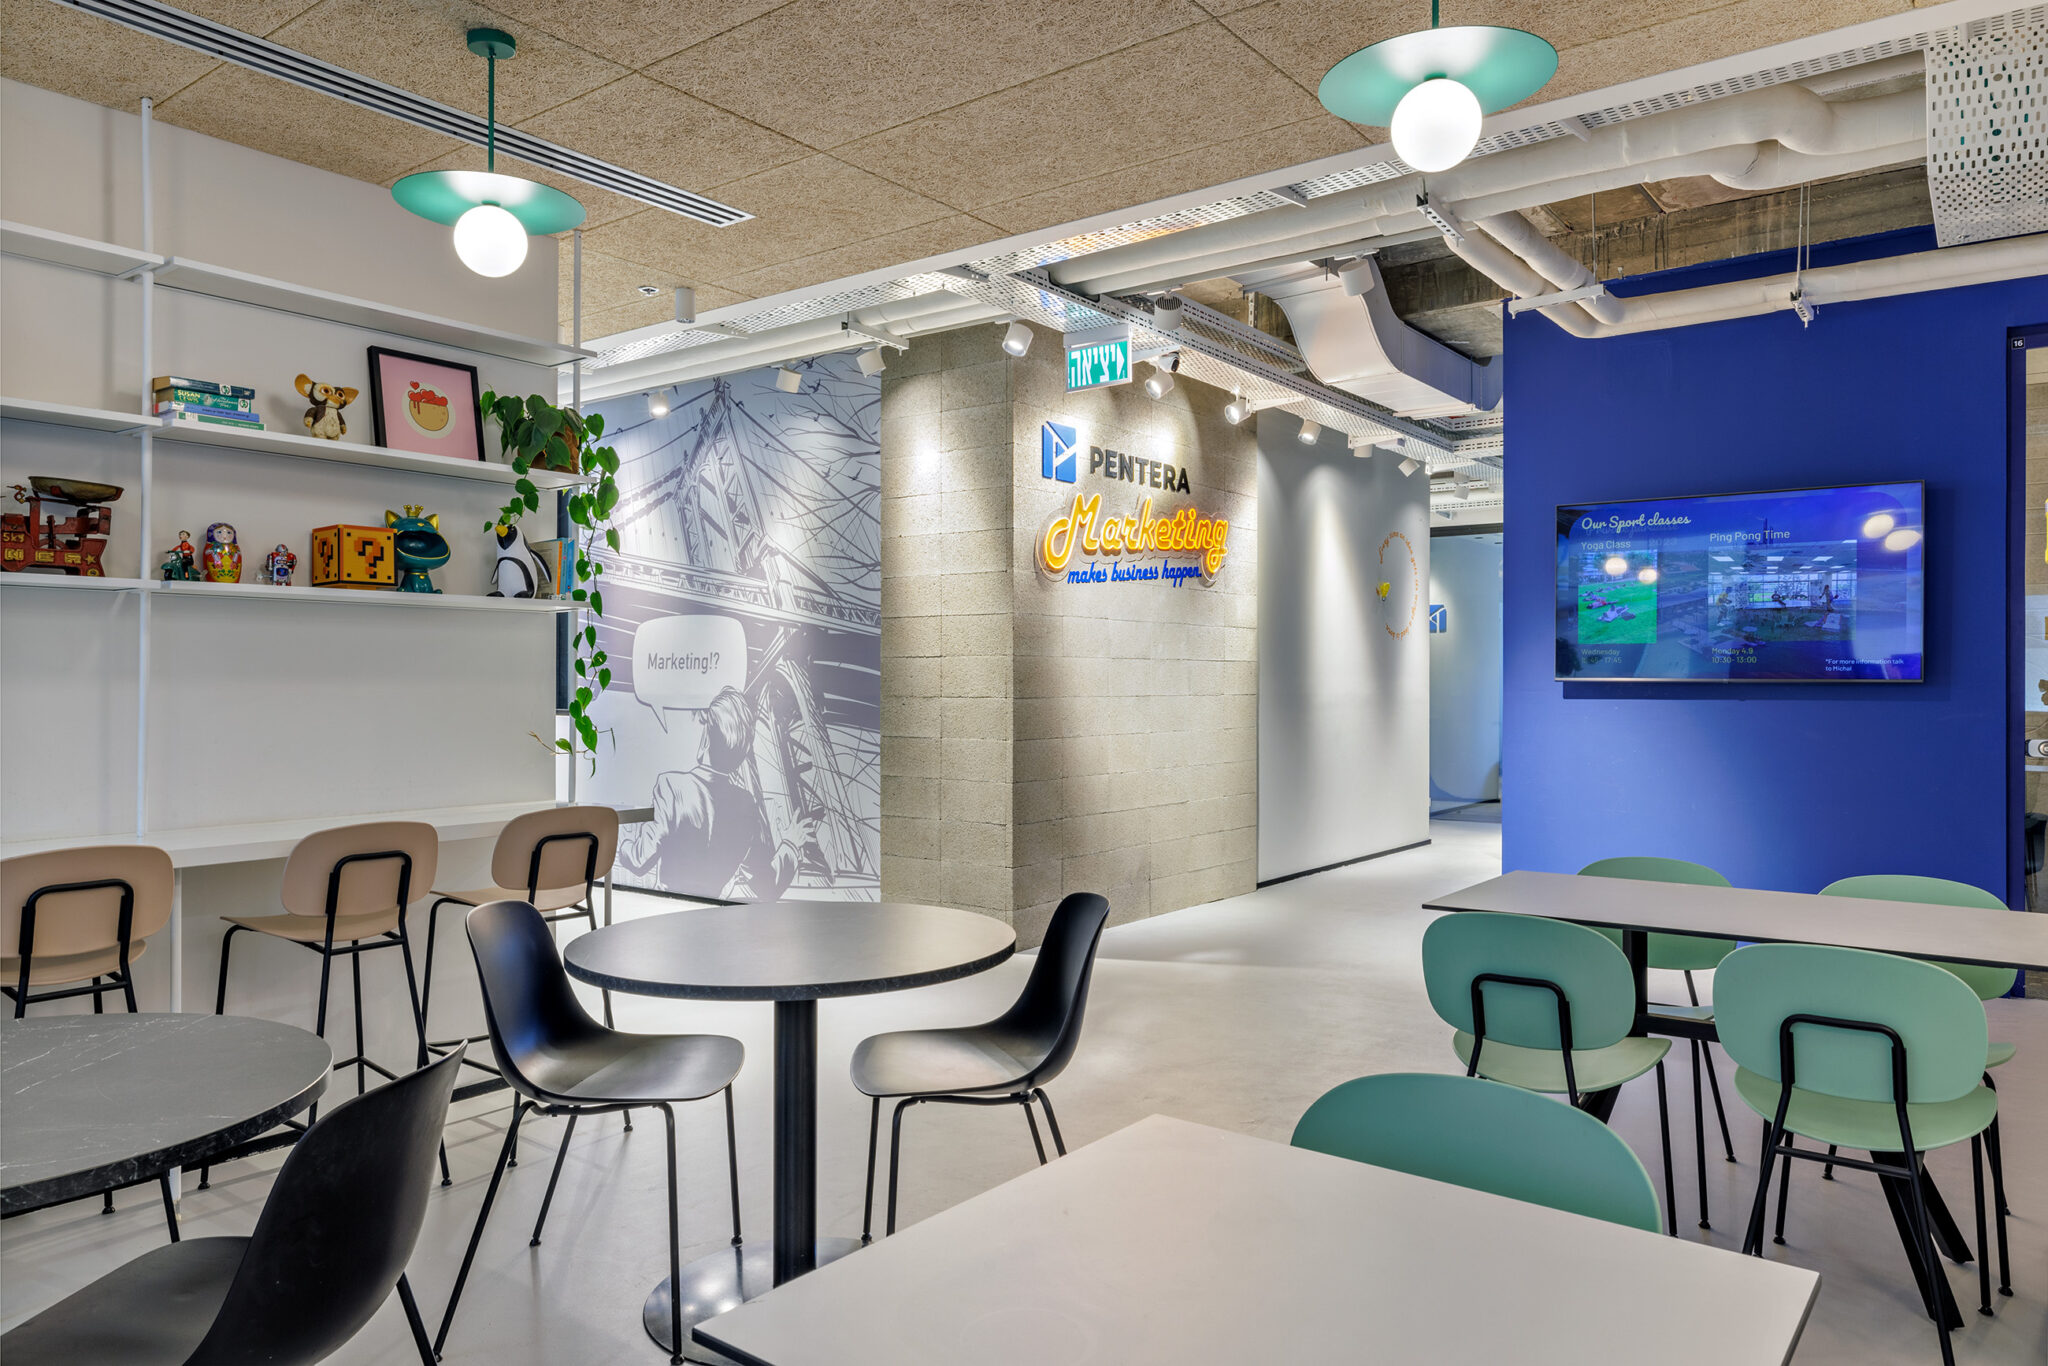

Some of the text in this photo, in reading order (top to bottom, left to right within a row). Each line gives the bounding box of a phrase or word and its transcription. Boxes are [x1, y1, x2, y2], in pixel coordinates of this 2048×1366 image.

[1071, 343, 1116, 388] יציאה
[1089, 445, 1191, 495] PENTERA
[1043, 493, 1229, 574] Marketing
[1581, 517, 1607, 530] Our
[1608, 513, 1646, 533] Sport
[1647, 511, 1692, 526] classes
[1581, 539, 1631, 552] Yoga Class
[1709, 529, 1791, 543] Ping Pong Time
[1066, 561, 1108, 585] makes
[1110, 560, 1159, 582] business
[1711, 647, 1740, 656] Monday
[647, 652, 720, 675] Marketing!?
